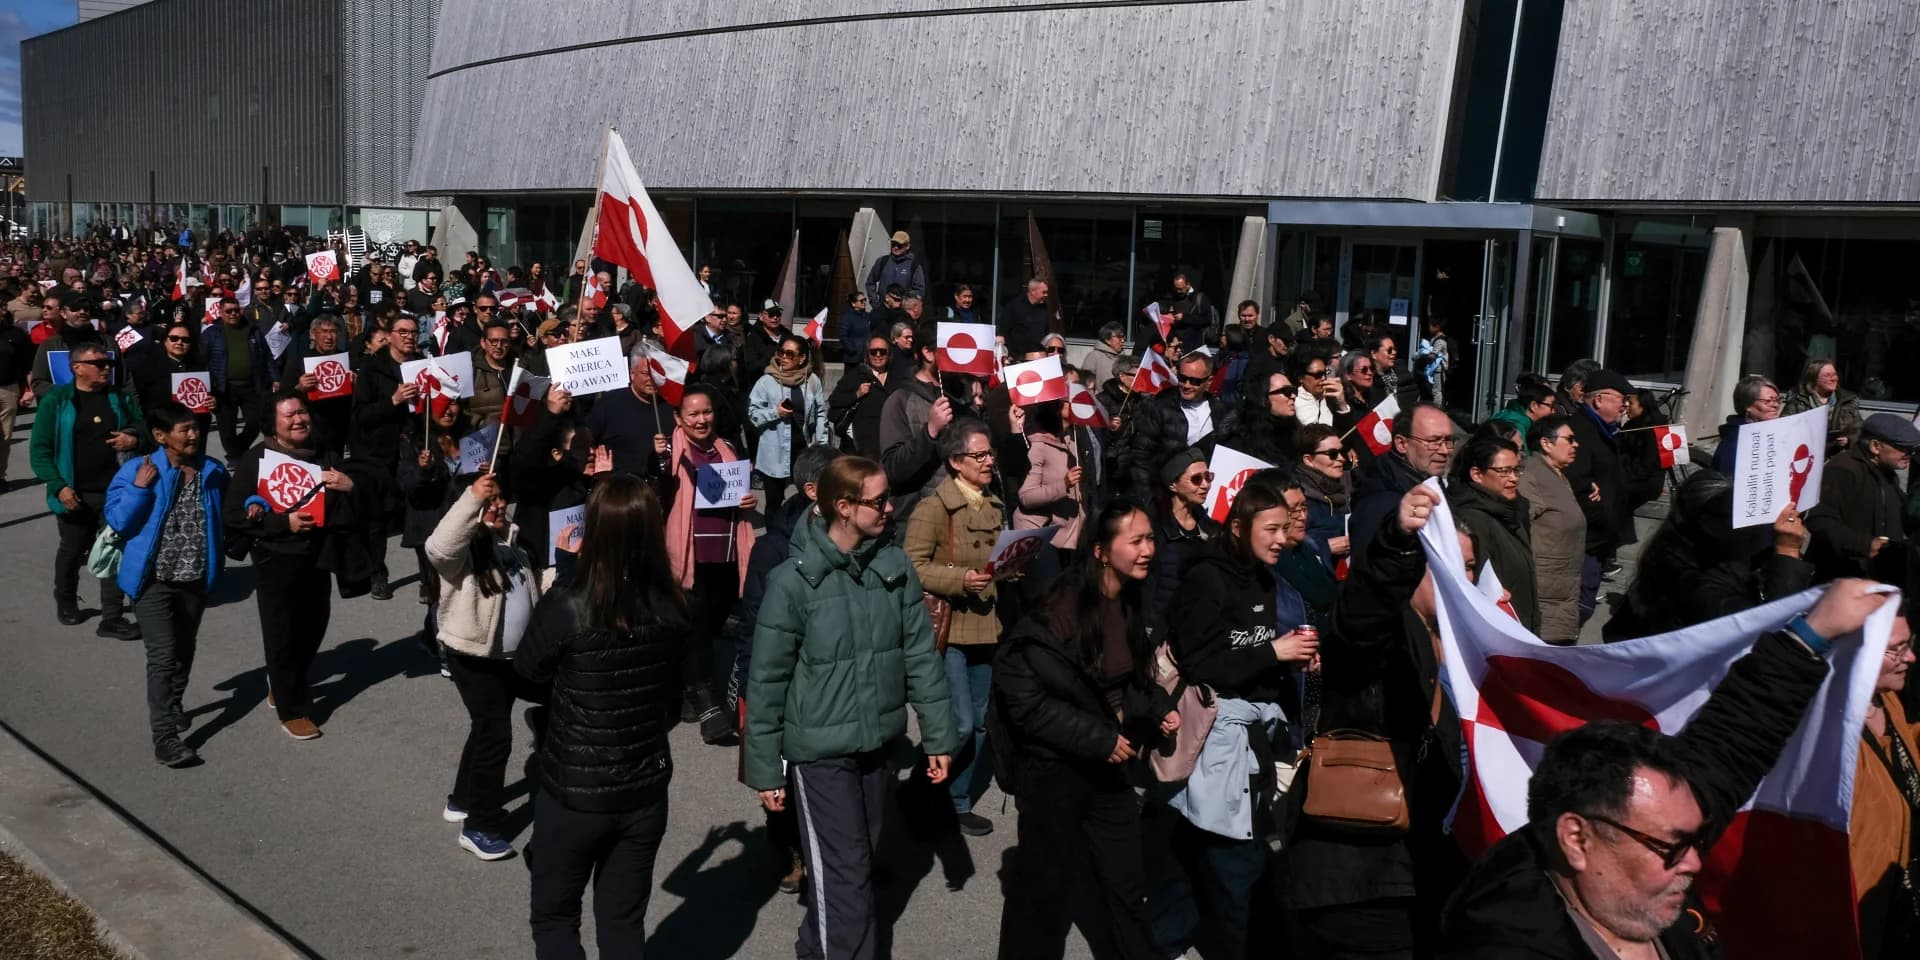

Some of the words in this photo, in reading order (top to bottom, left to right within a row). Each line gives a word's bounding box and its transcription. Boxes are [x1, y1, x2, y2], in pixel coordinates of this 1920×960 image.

[569, 346, 600, 360] MAKE
[314, 361, 345, 379] USA
[564, 360, 613, 375] AMERICA
[179, 379, 206, 394] USA
[562, 379, 579, 391] GO
[582, 373, 619, 388] AWAY!!
[1751, 432, 1761, 471] nunaat
[274, 464, 315, 488] USA
[727, 467, 741, 477] ARE
[728, 480, 744, 488] FOR
[1746, 475, 1759, 518] Kalaallit
[1761, 472, 1774, 515] Kalaallit
